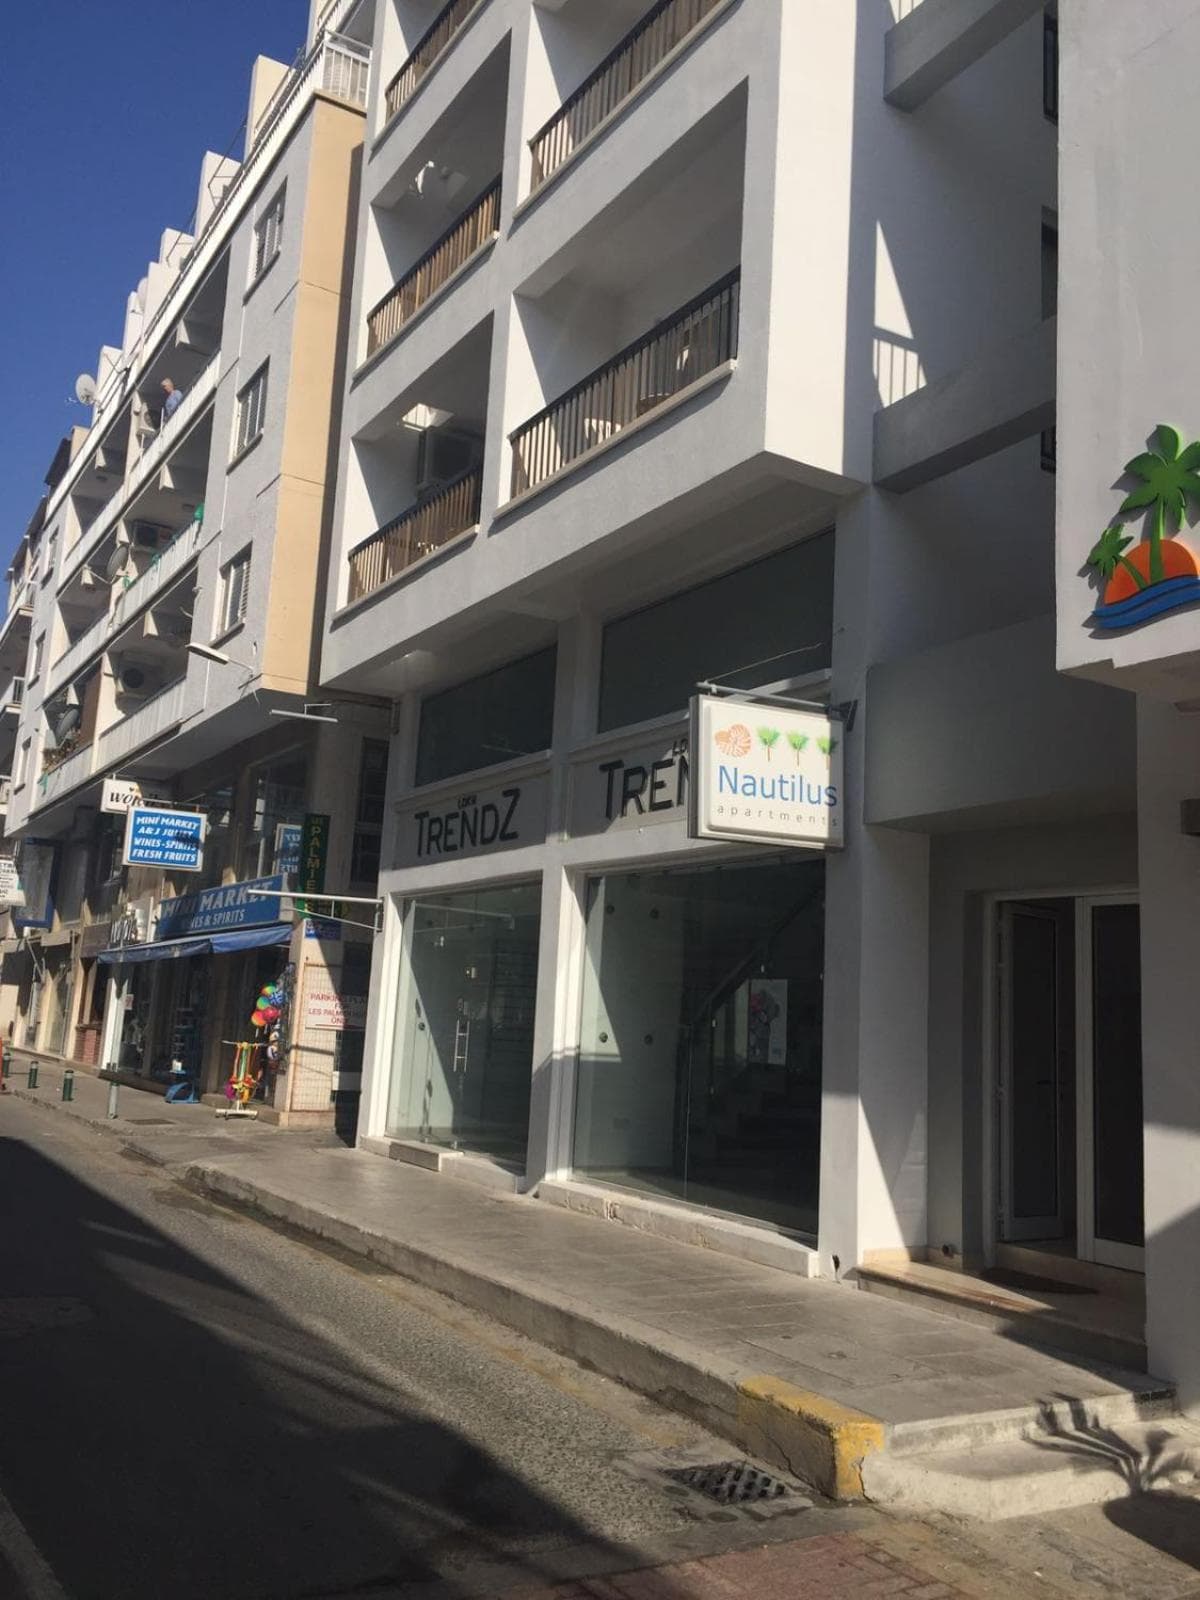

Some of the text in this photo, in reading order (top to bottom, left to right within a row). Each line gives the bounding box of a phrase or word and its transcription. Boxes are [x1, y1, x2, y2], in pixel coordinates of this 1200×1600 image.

[718, 764, 838, 807] Nautilus
[136, 815, 199, 830] MINI MARKET
[415, 787, 521, 858] TRENDZ
[717, 804, 838, 827] apartments
[132, 848, 197, 863] FRESH FRUITS
[199, 880, 274, 912] MARKET
[213, 909, 246, 925] SPIRITS
